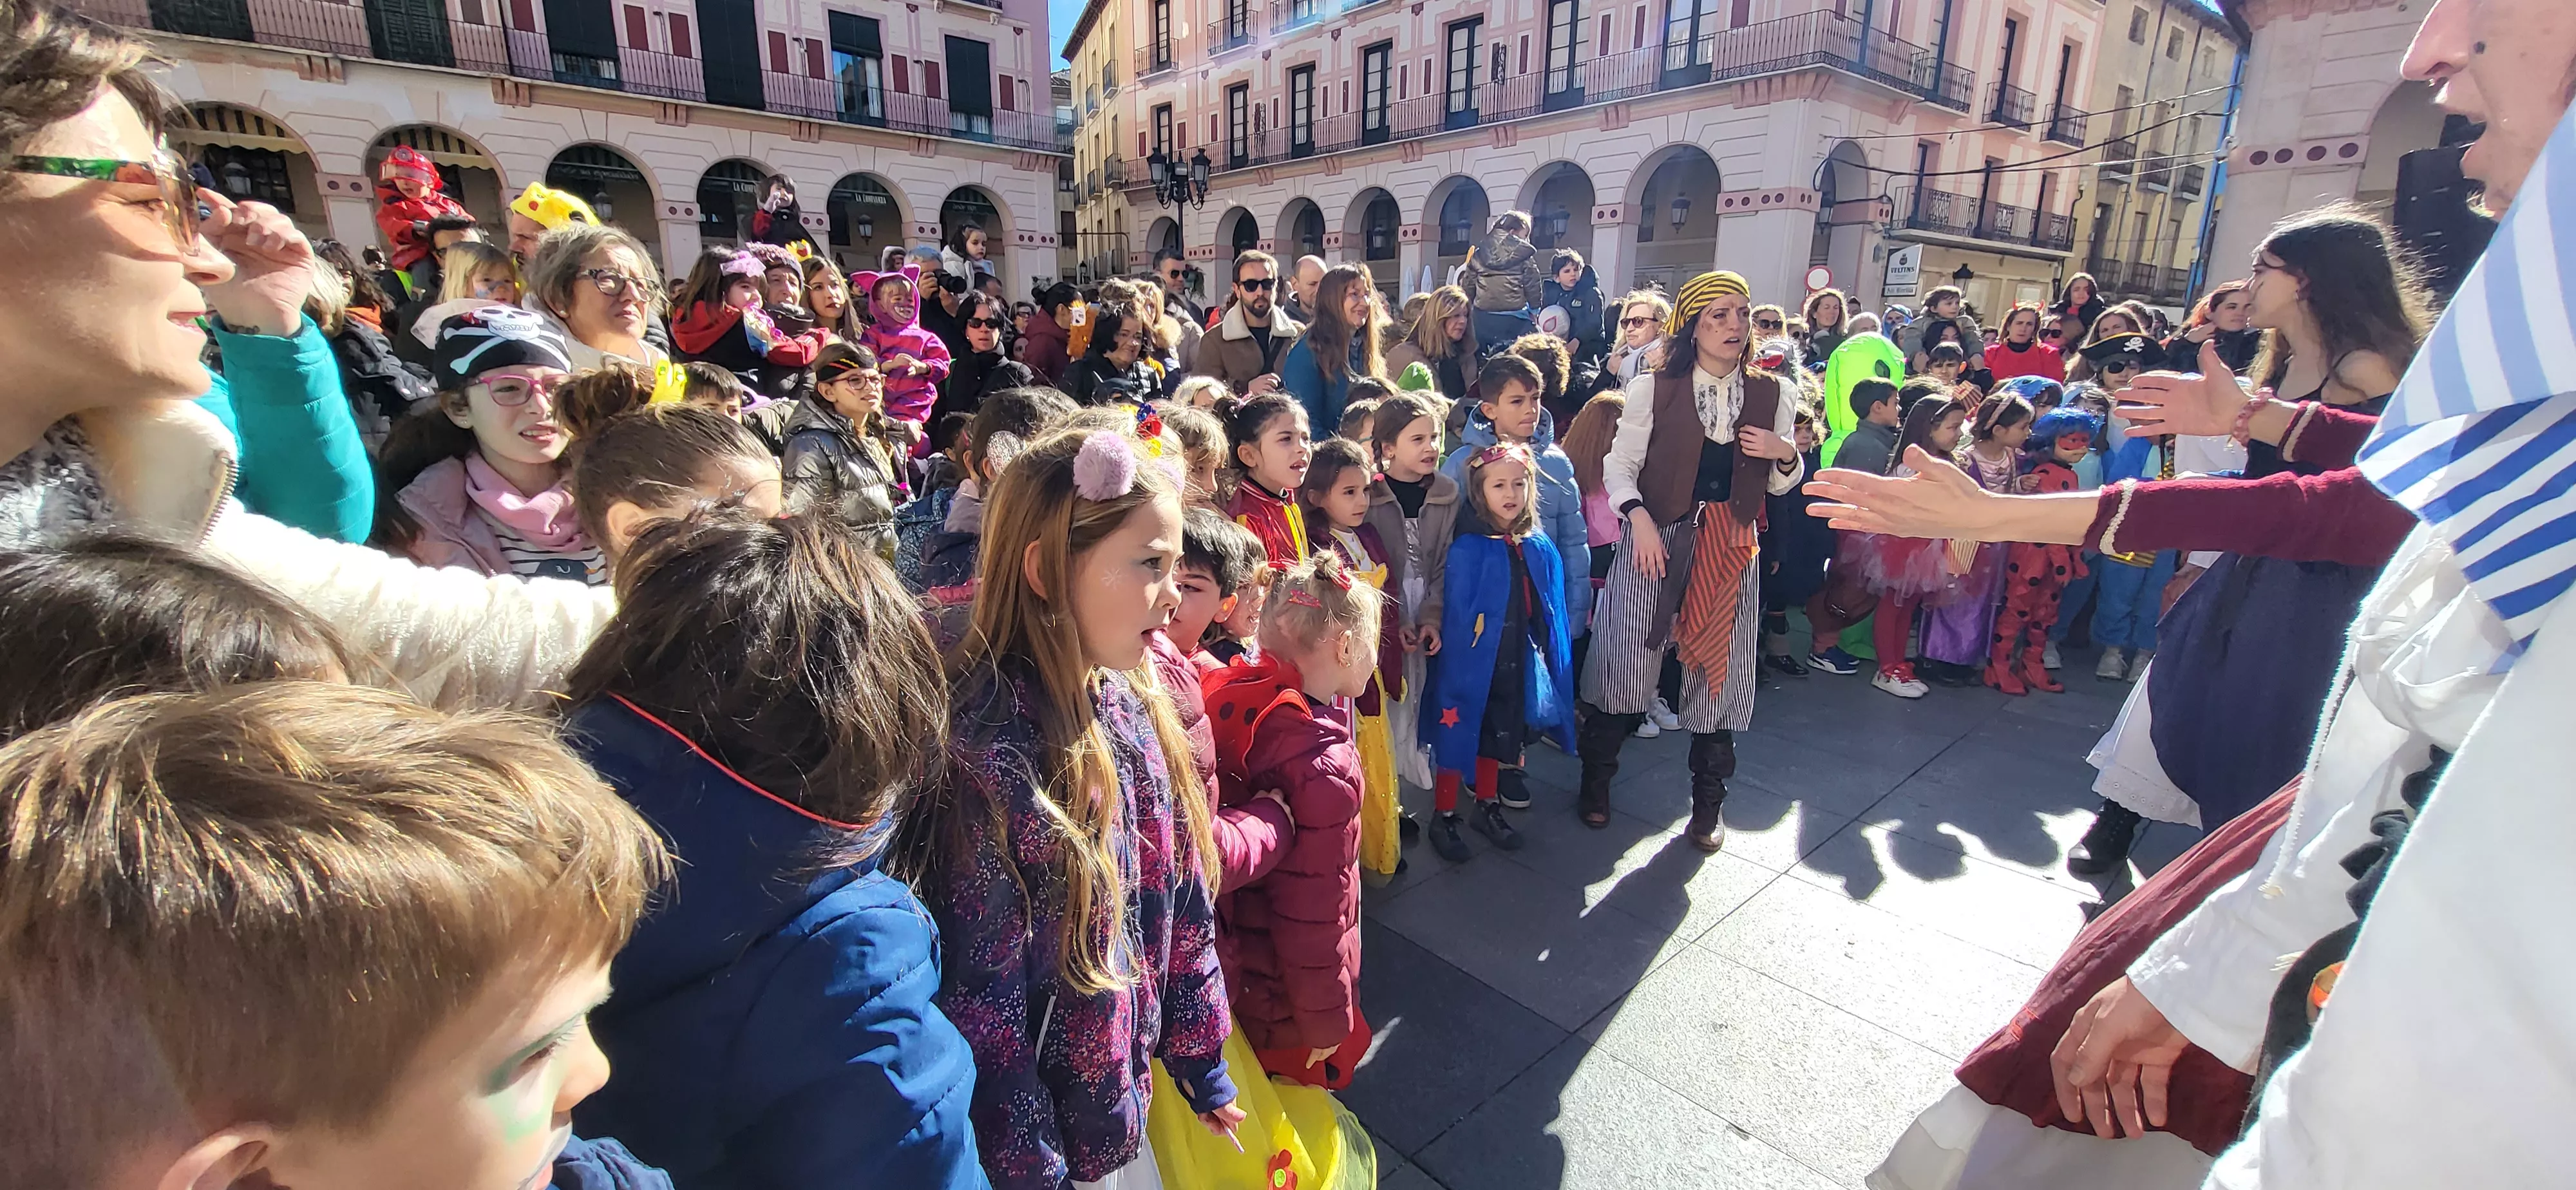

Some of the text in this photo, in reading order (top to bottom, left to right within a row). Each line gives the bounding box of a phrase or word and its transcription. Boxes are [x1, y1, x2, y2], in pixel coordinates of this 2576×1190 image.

[733, 181, 741, 191] LA
[855, 193, 887, 204] LA CONFIANZA
